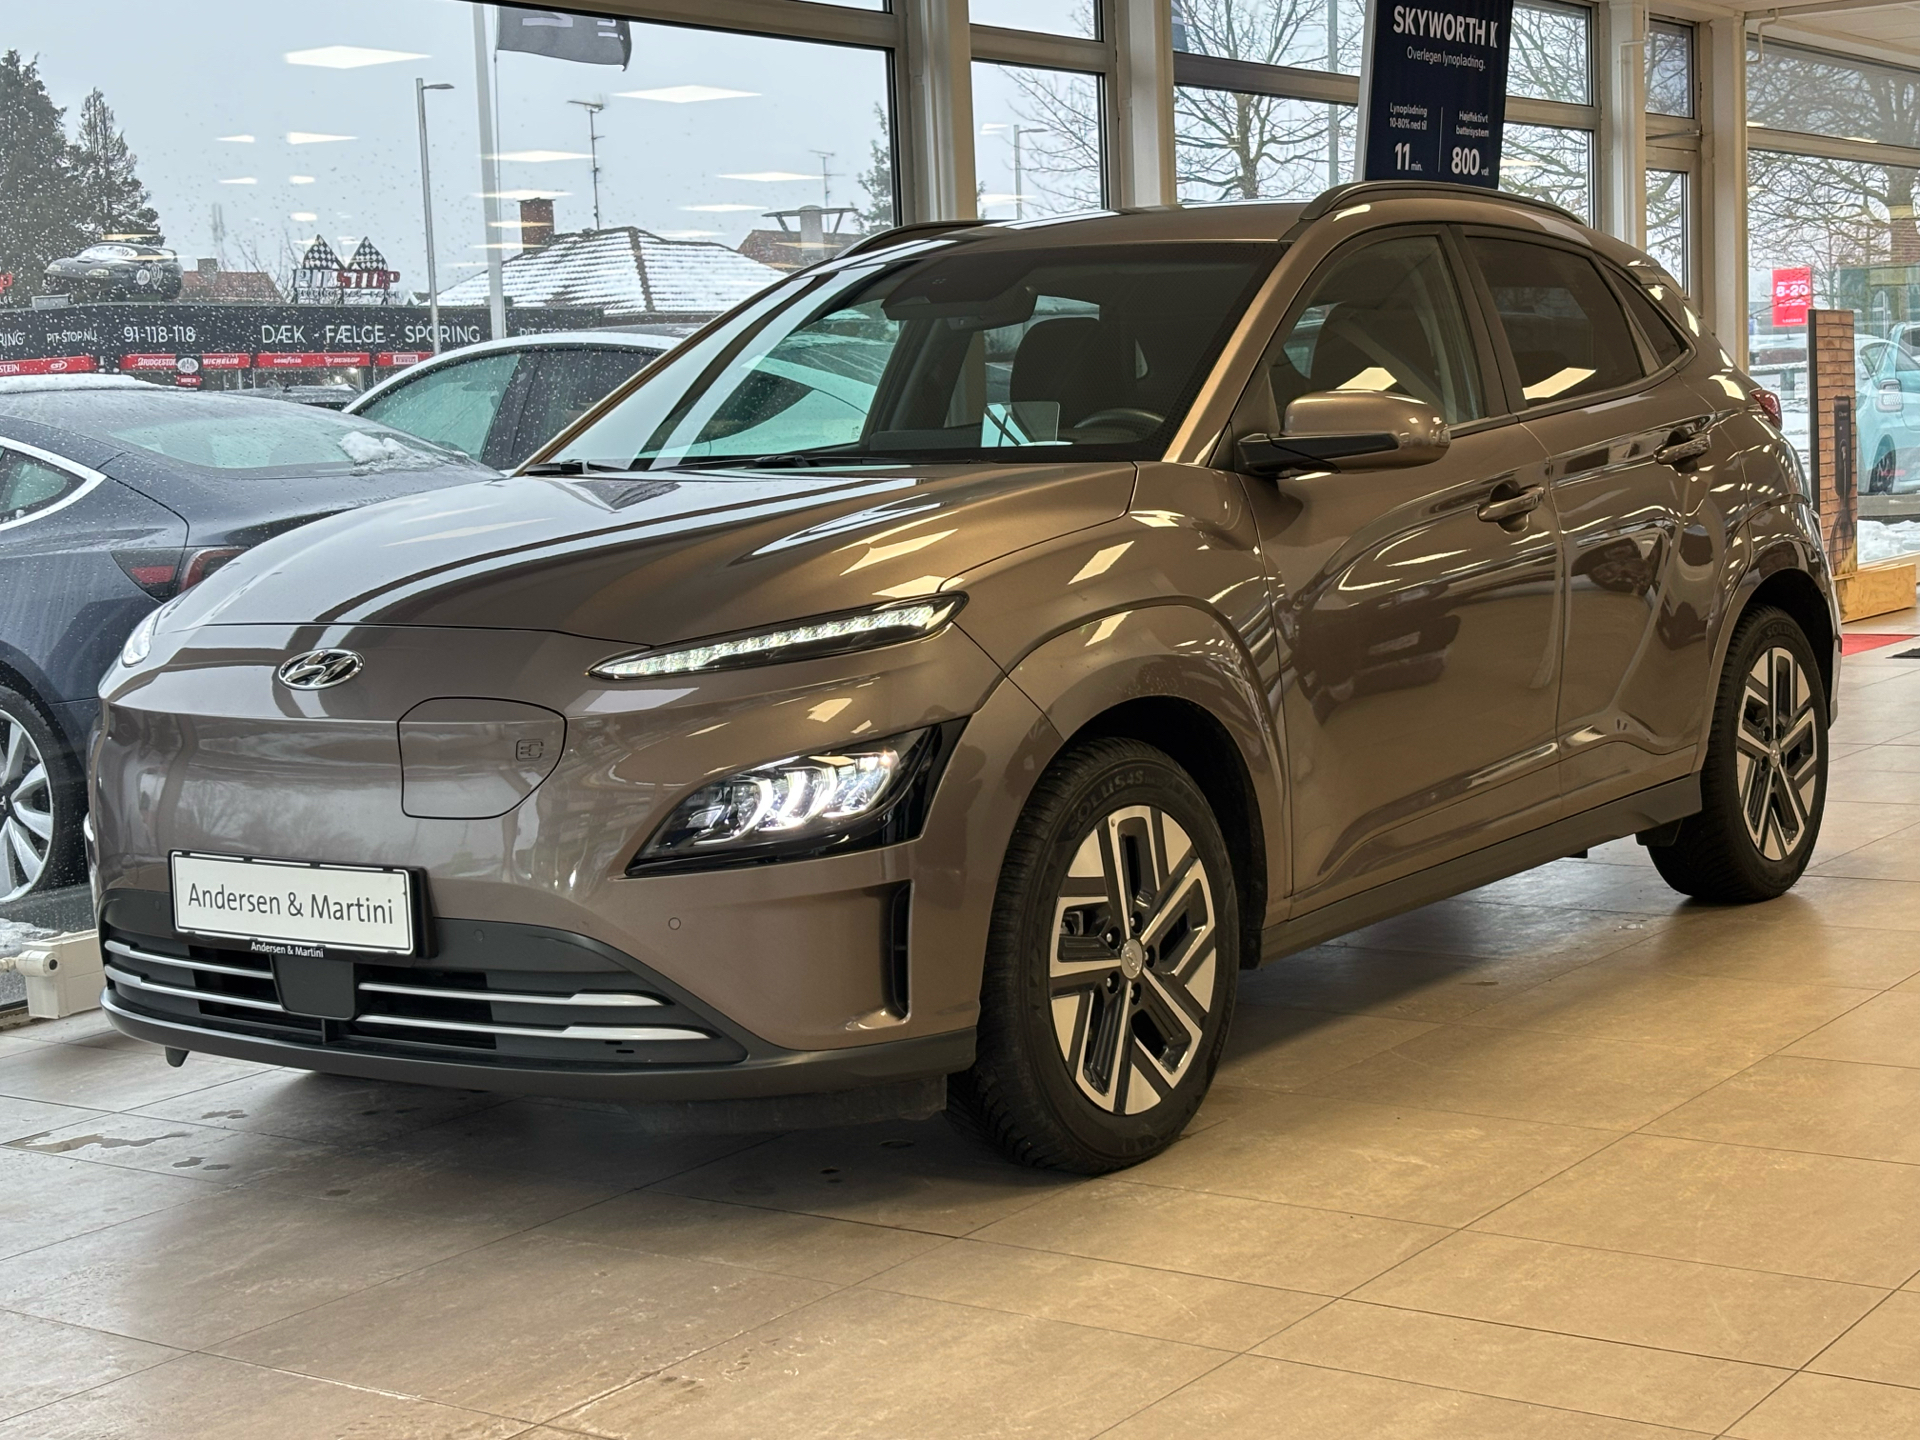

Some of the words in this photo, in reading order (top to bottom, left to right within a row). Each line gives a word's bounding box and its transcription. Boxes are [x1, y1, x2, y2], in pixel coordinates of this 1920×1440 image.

[1393, 6, 1486, 46] SKYWORTH
[1490, 21, 1499, 49] K
[1407, 46, 1441, 65] Overlegen
[1442, 50, 1486, 72] lynopladning.
[1389, 102, 1428, 118] Lynopladning
[1389, 117, 1410, 129] 10-80%
[1410, 120, 1421, 130] ned
[1394, 142, 1411, 171] 11
[1410, 160, 1423, 171] min.
[1451, 146, 1480, 176] 800
[294, 268, 336, 288] PIT
[337, 269, 401, 290] STOP
[1775, 284, 1809, 297] 8-20
[123, 326, 197, 343] 91-118-118
[261, 325, 307, 344] DÆK
[325, 325, 387, 344] FÆLGE
[1068, 774, 1128, 838] SOLUS
[187, 882, 281, 915] Andersen
[287, 891, 304, 918] &
[310, 893, 394, 925] Martini
[250, 940, 286, 955] Andersen
[286, 945, 294, 956] &
[294, 946, 324, 959] Martini
